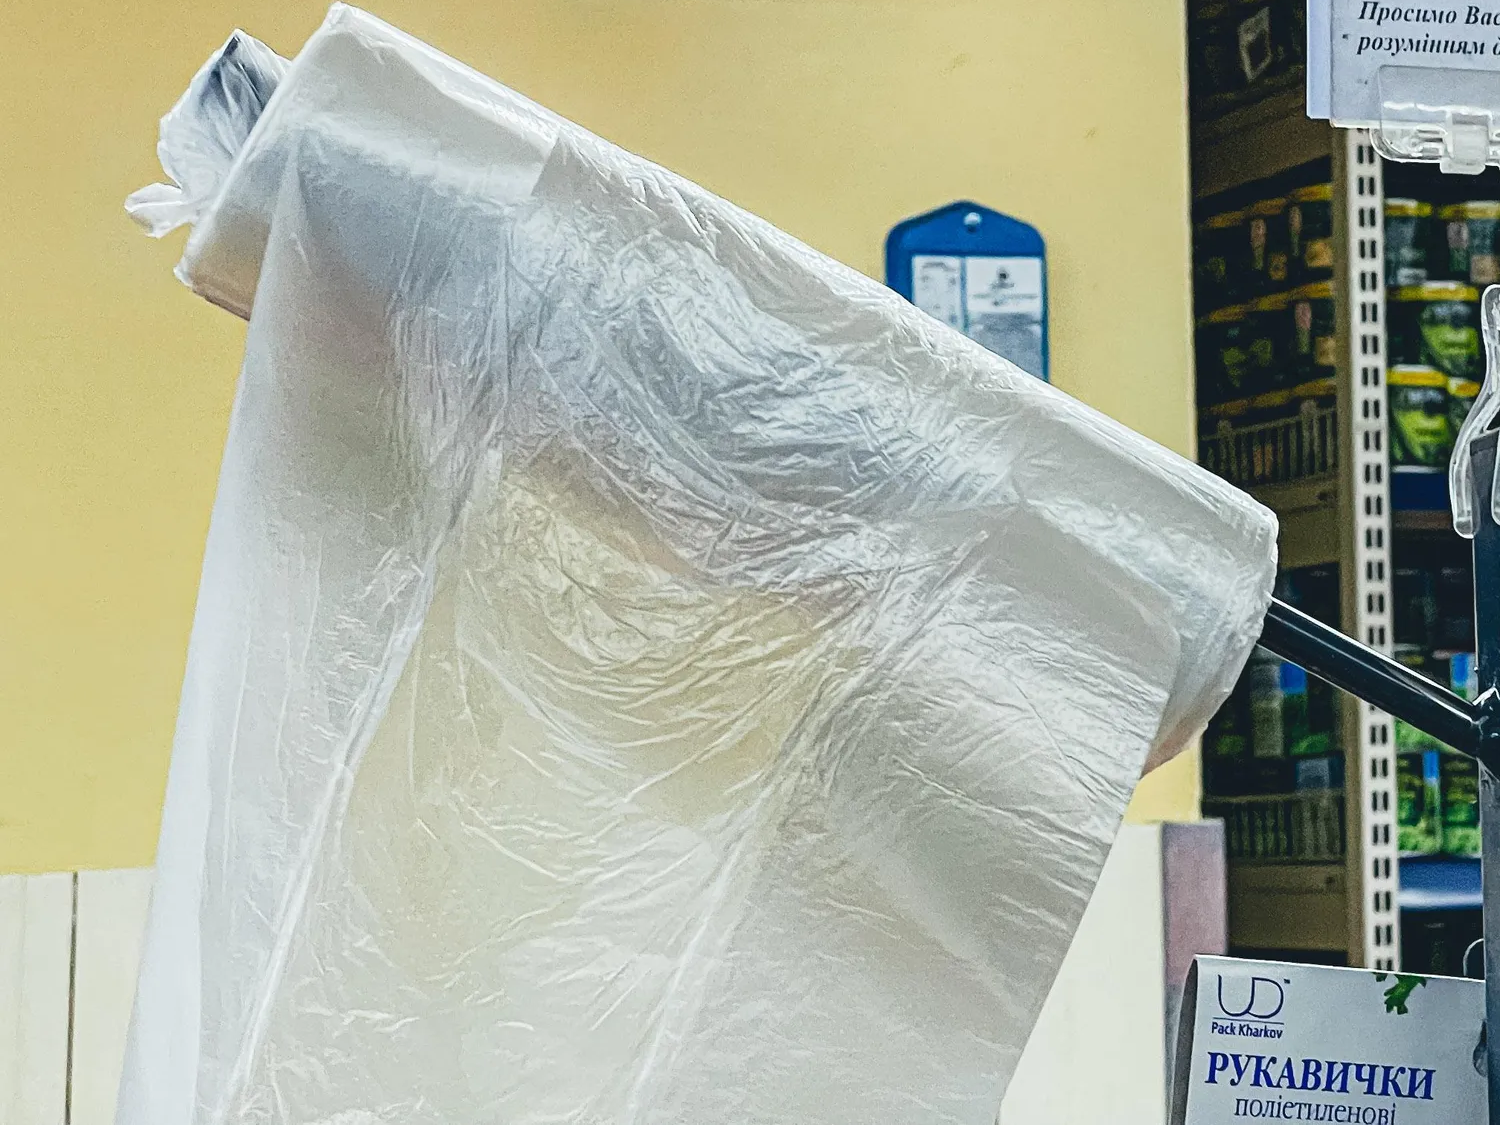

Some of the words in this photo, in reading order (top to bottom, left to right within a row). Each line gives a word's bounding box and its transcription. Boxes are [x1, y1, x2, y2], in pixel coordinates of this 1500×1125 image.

[1358, 1, 1457, 25] Просимо
[1356, 33, 1485, 56] розумінням
[1211, 1021, 1236, 1036] Pack
[1238, 1024, 1283, 1039] Kharkov
[1204, 1051, 1437, 1100] РУКАВИЧКИ
[1234, 1095, 1396, 1125] поліетиленові
